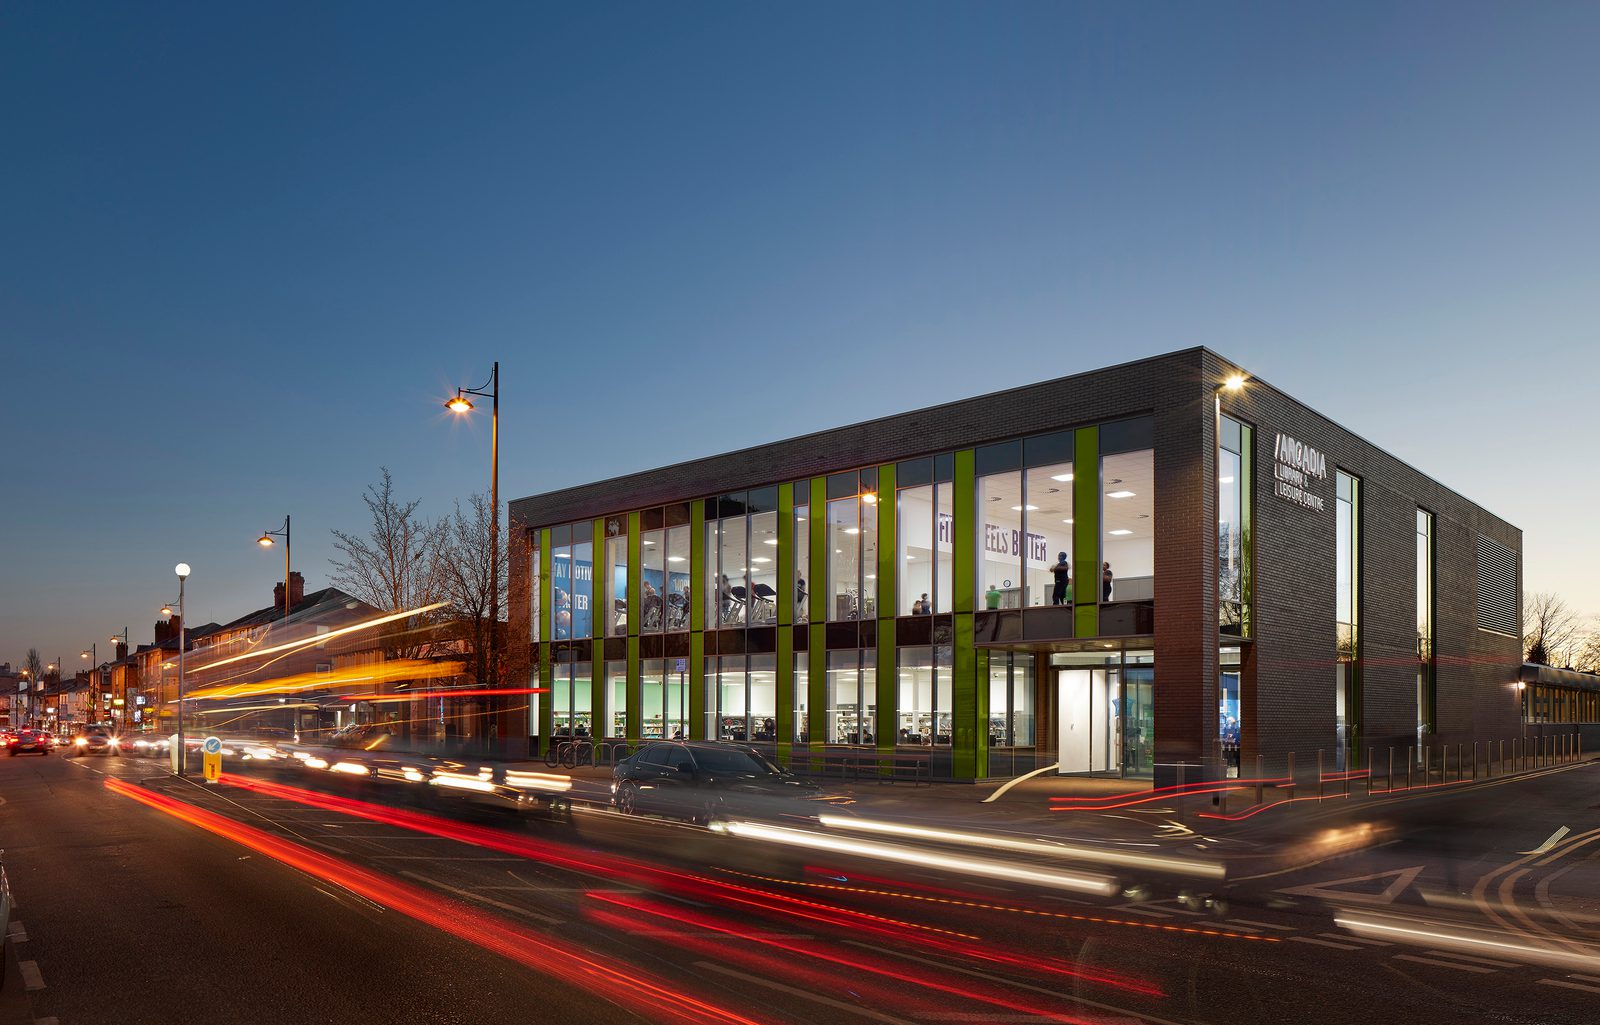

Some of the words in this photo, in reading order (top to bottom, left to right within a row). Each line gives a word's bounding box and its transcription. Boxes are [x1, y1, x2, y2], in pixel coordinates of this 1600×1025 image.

[1279, 433, 1327, 479] ARCADIA
[1279, 462, 1303, 487] LIBRARY
[1303, 474, 1309, 488] &
[1279, 481, 1303, 503] LEISURE
[1303, 491, 1324, 511] CENTRE
[985, 523, 1008, 554] EELS
[554, 562, 567, 579] TAY
